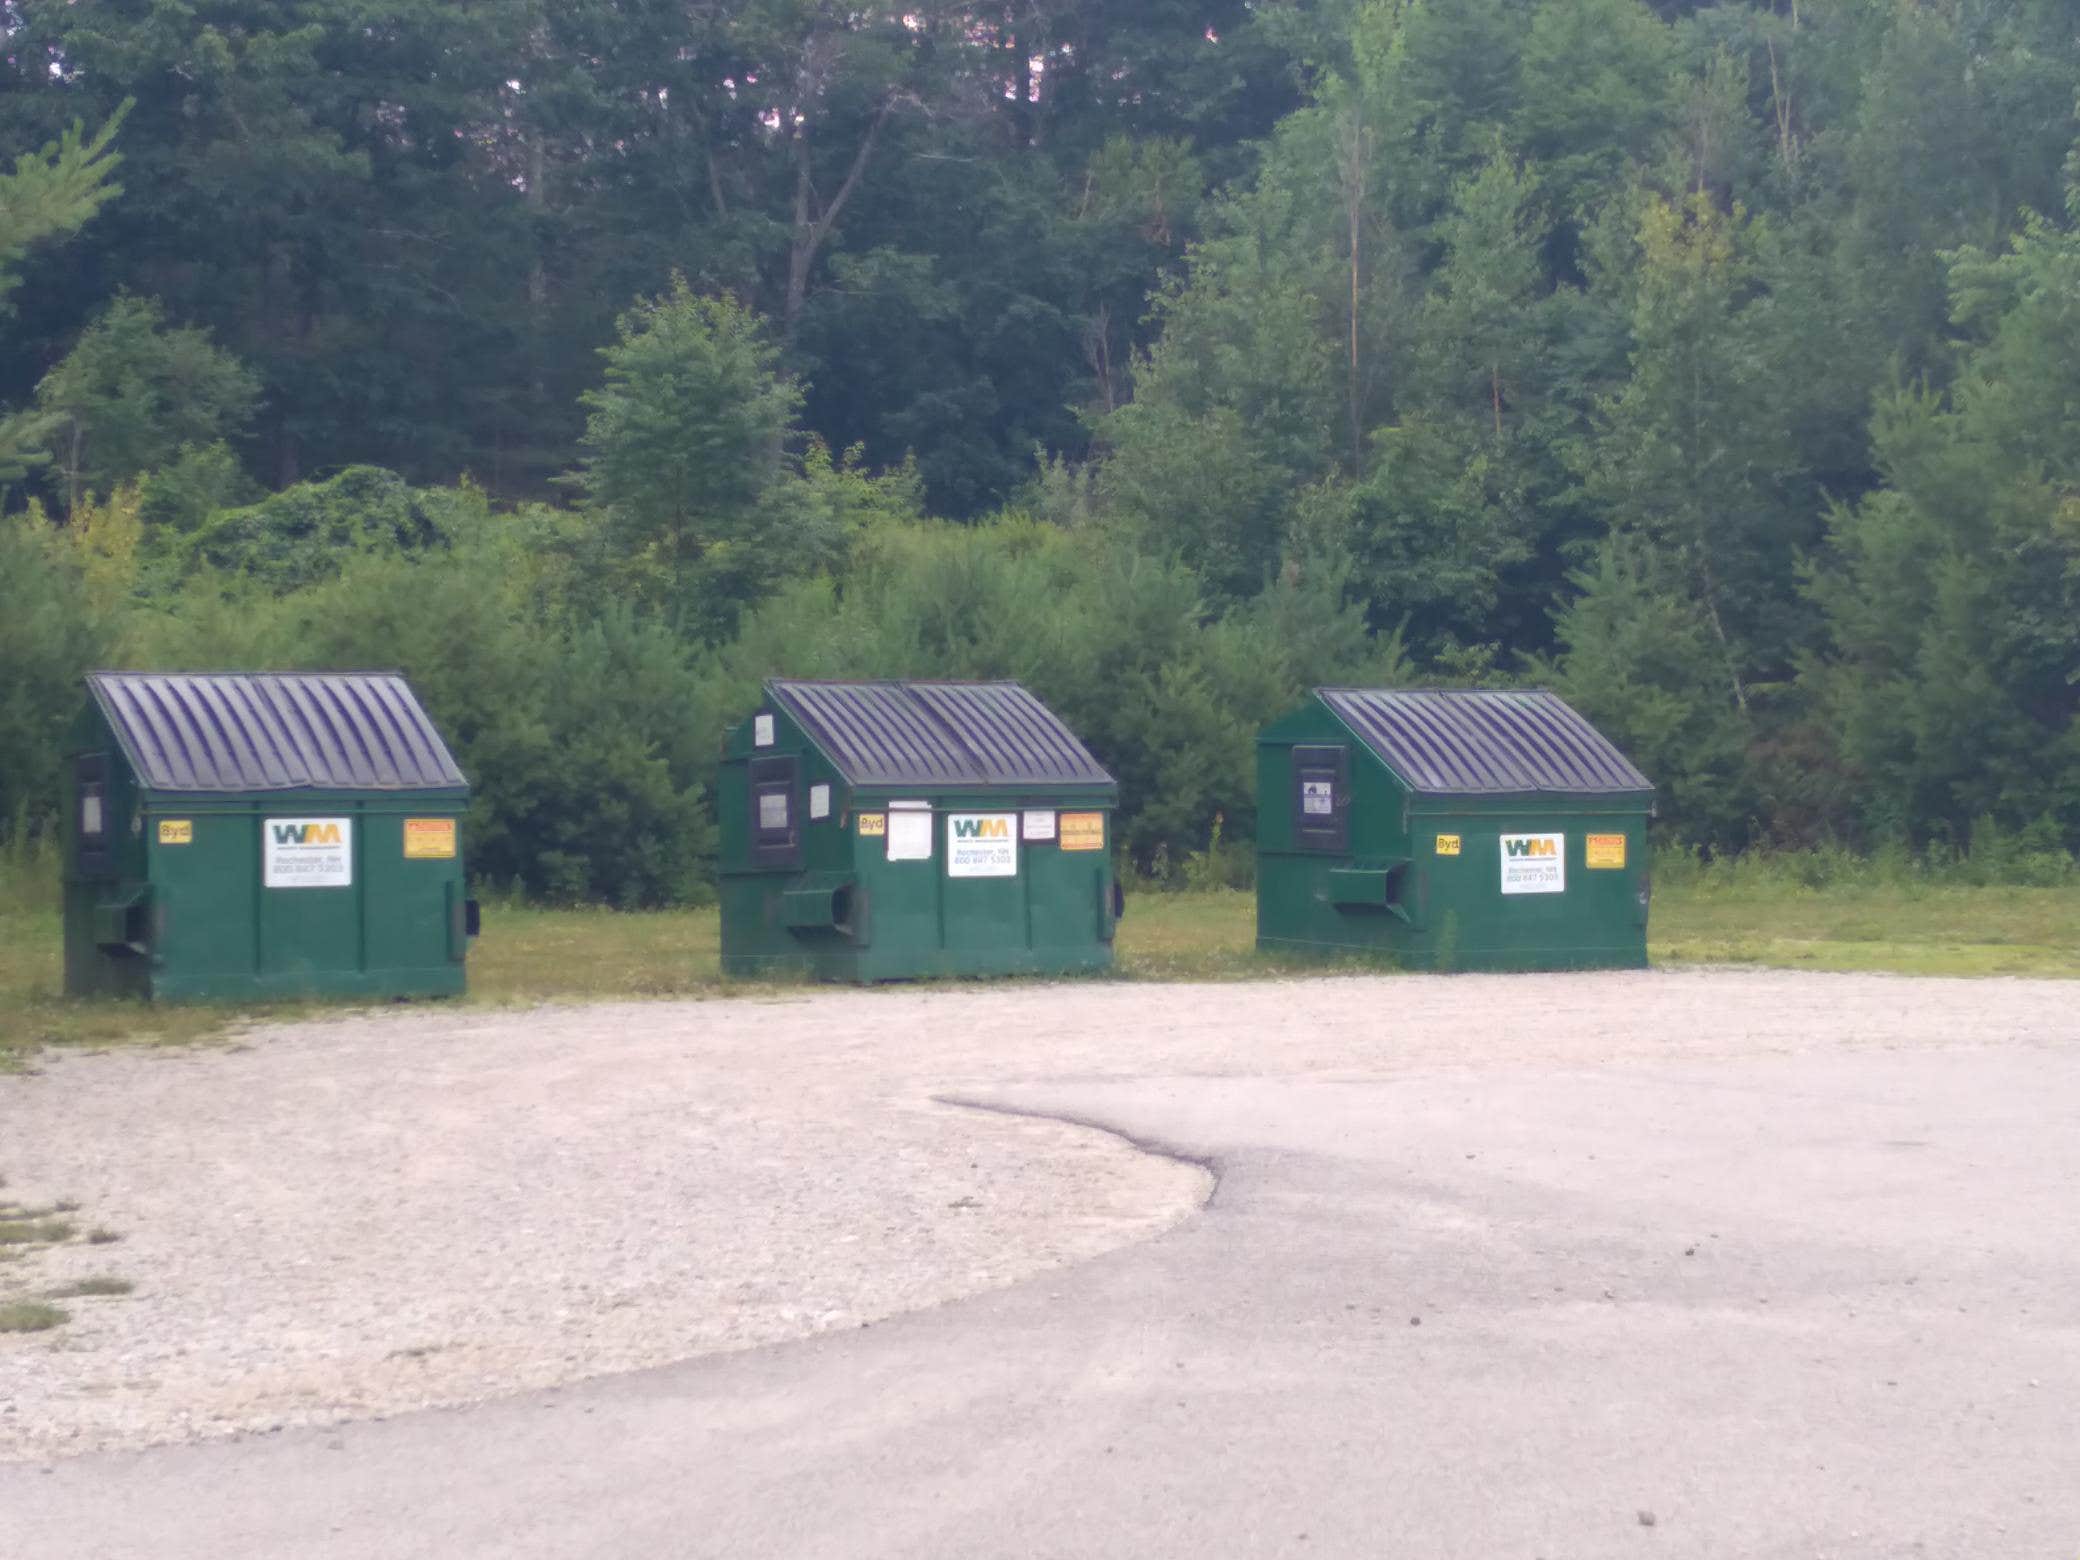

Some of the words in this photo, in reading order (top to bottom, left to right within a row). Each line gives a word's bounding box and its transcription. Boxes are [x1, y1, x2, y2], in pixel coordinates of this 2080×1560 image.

[272, 824, 342, 844] WM
[953, 819, 1008, 837] WM
[1505, 839, 1557, 856] WM
